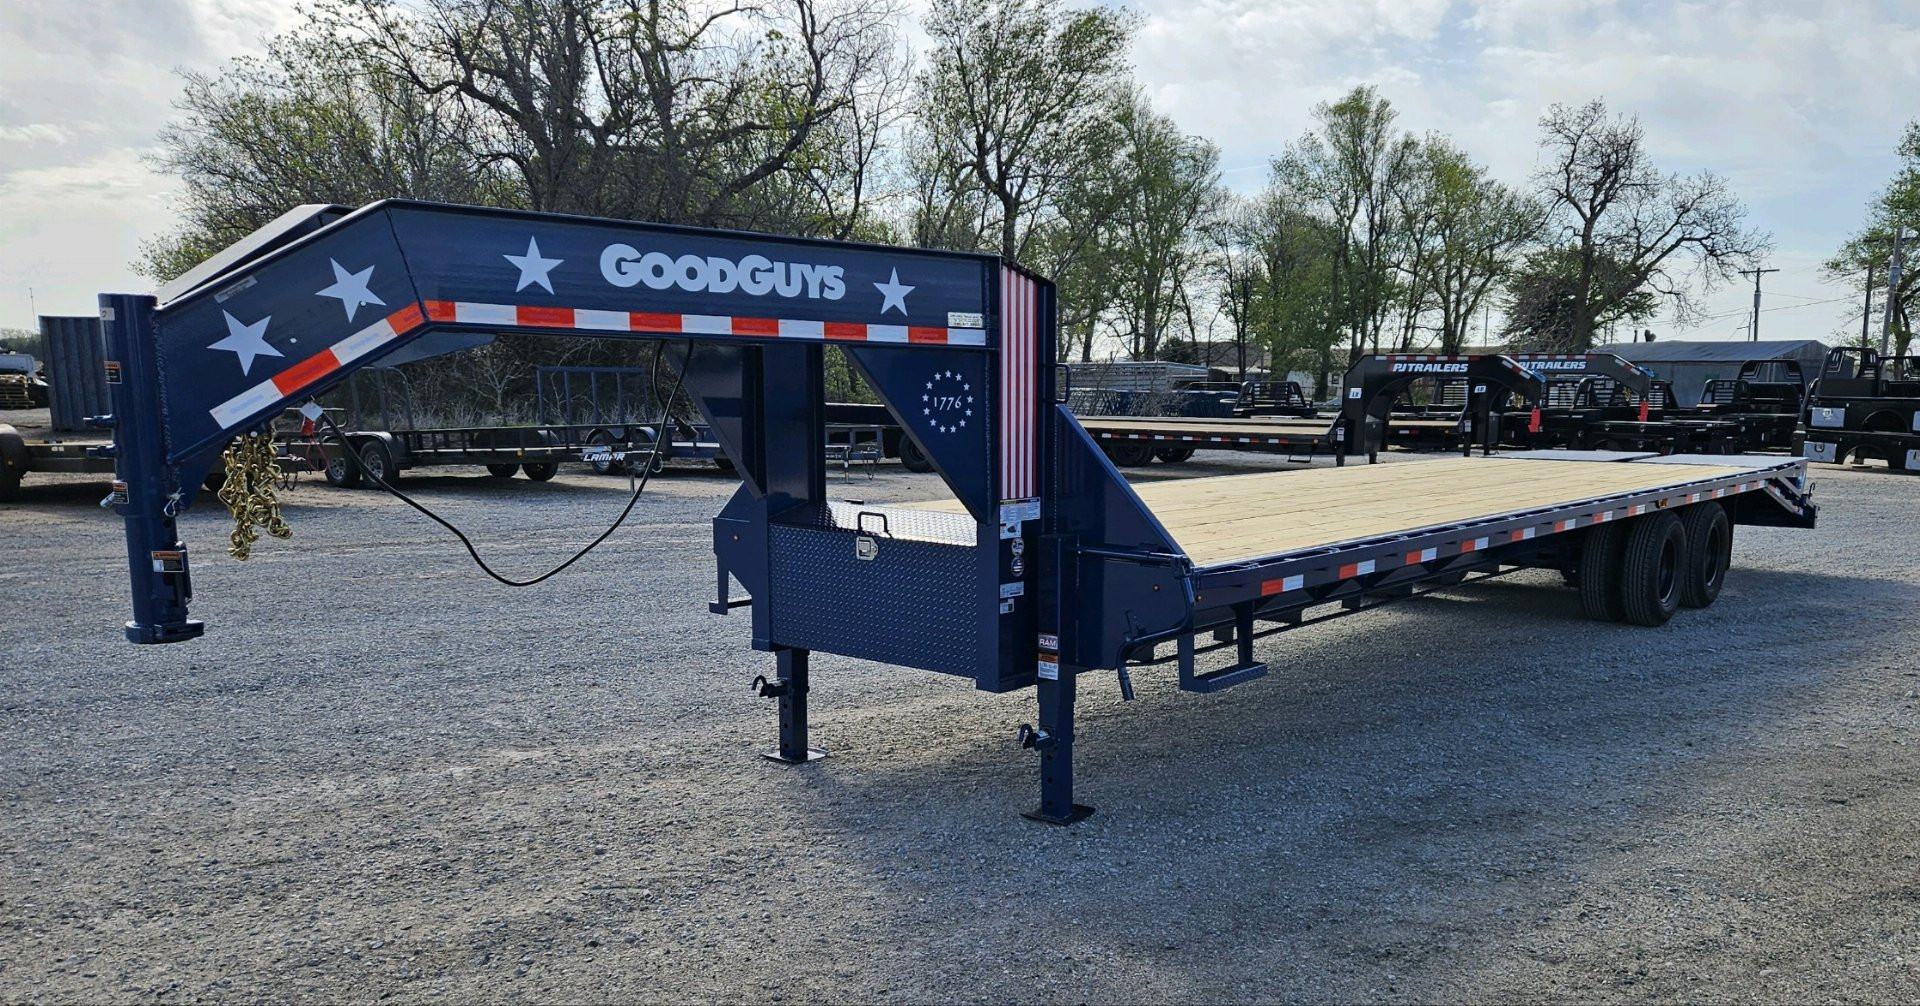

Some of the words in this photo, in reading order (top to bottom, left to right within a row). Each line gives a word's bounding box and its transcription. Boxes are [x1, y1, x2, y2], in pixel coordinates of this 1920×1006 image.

[600, 243, 846, 300] GOODGUYS
[1408, 363, 1469, 372] TRAILERS
[1530, 361, 1587, 370] TRAILERS
[933, 395, 962, 411] 1776
[1039, 638, 1057, 647] RAM
